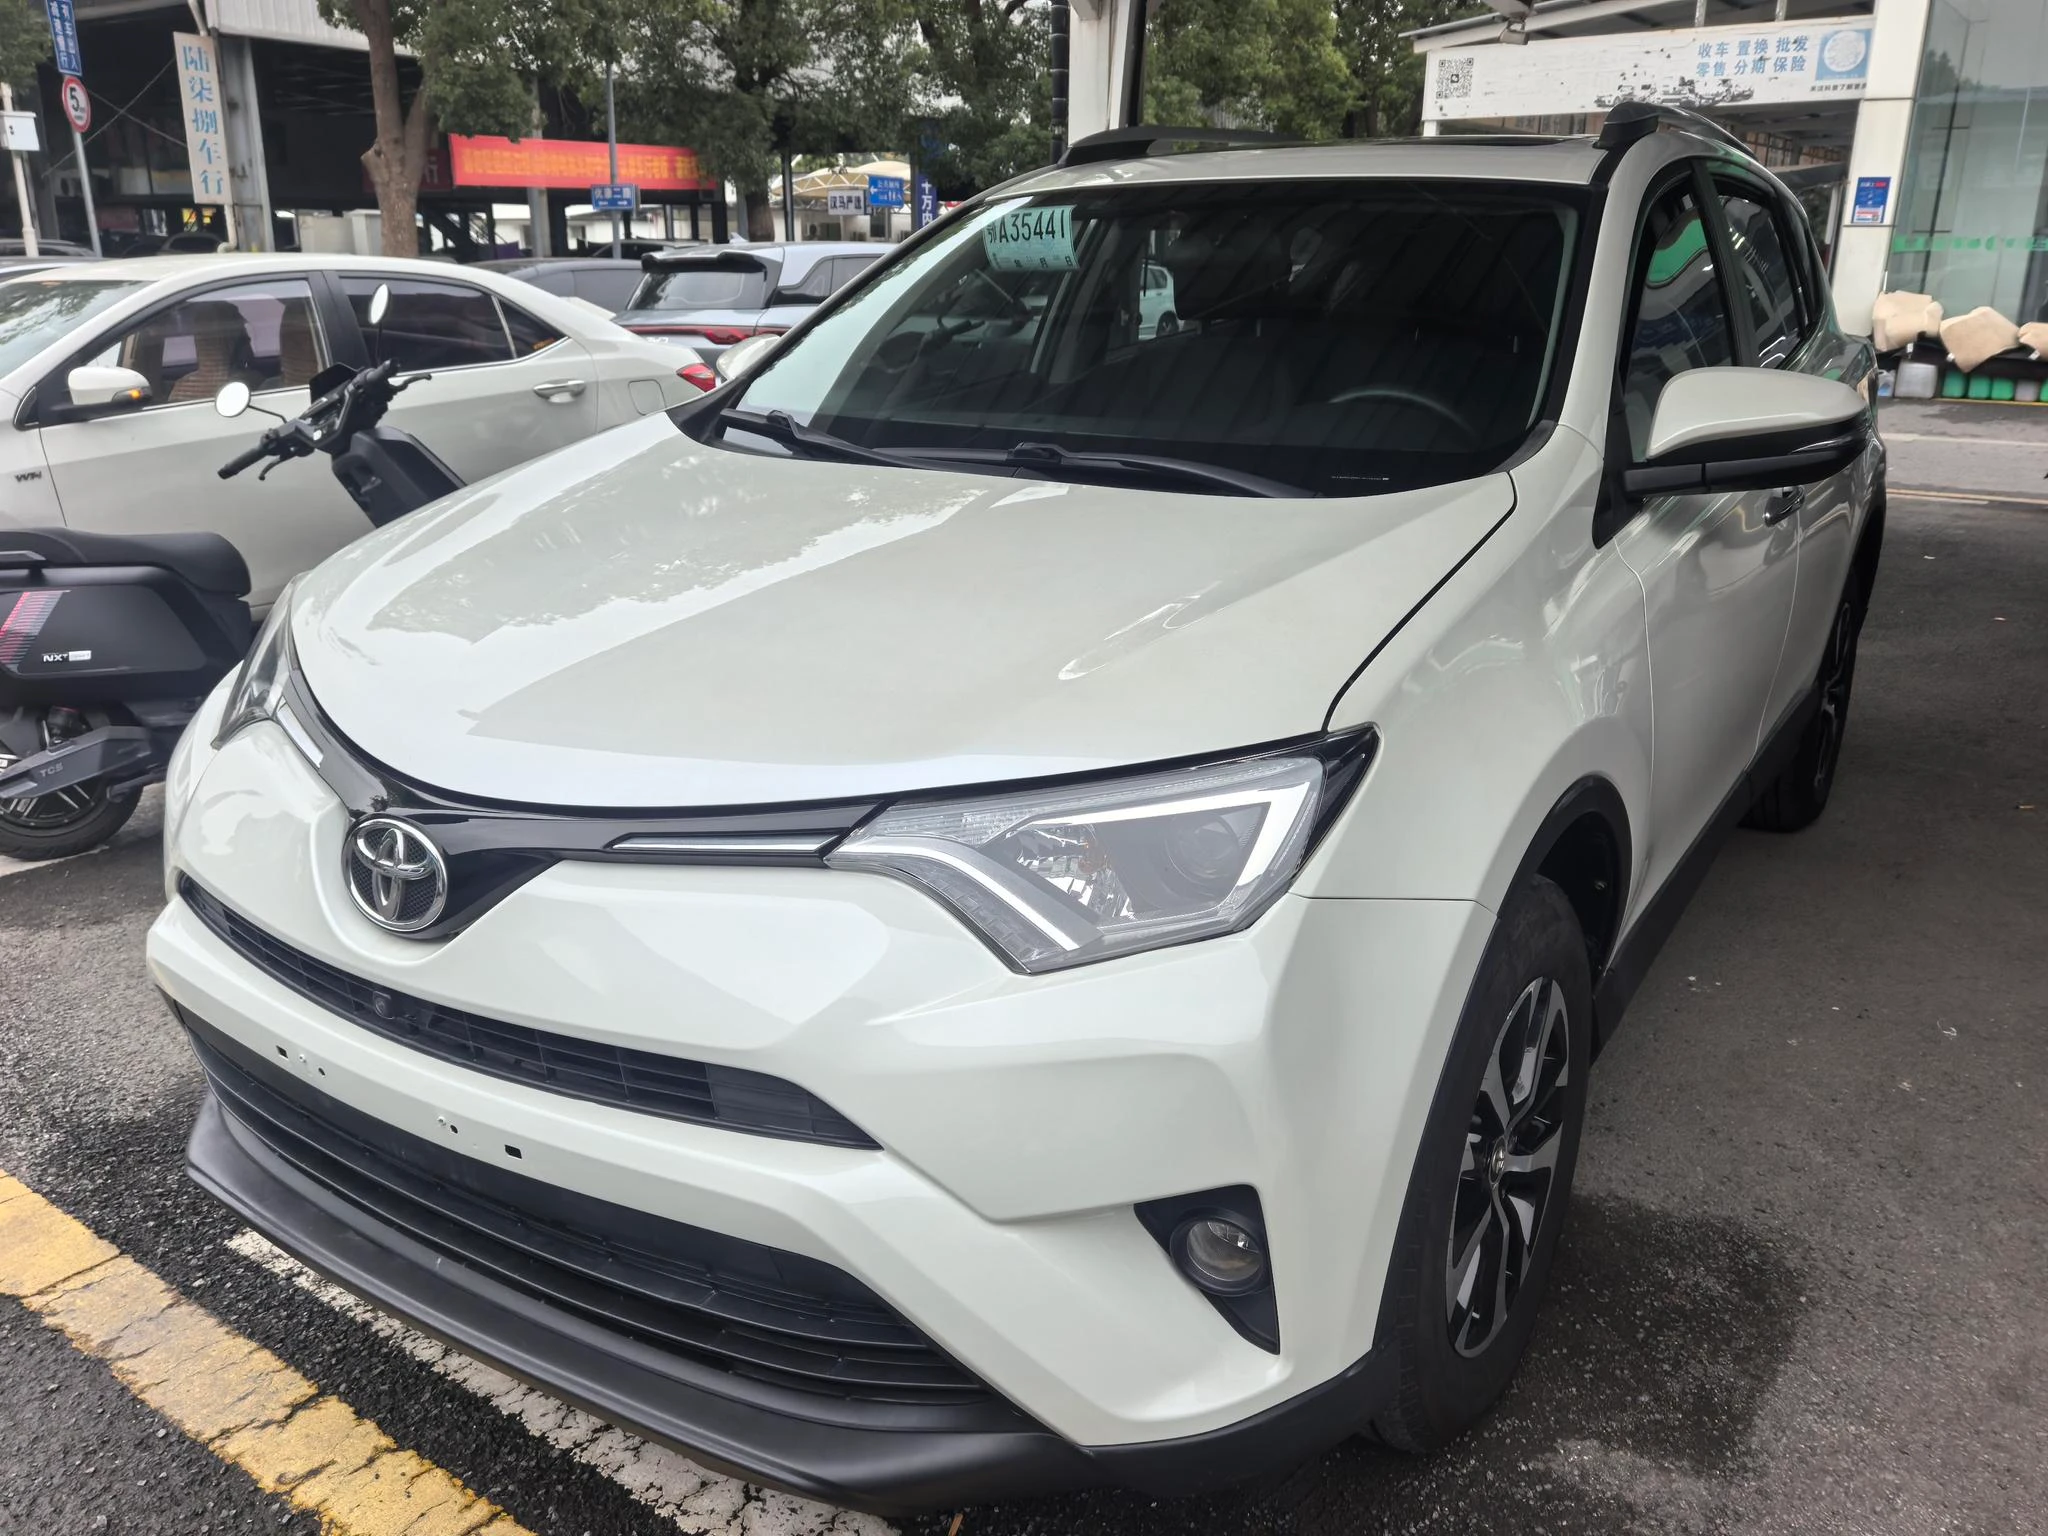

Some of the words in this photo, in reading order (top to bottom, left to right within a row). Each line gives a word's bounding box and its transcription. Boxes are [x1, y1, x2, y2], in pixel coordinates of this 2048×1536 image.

[1697, 42, 1730, 59] 收车
[1736, 38, 1769, 57] 置换
[1775, 35, 1809, 53] 批发
[1696, 61, 1727, 77] 零售
[1734, 57, 1766, 76] 分期
[1773, 55, 1807, 72] 保险
[69, 86, 80, 112] 5
[921, 181, 933, 227] 十万内
